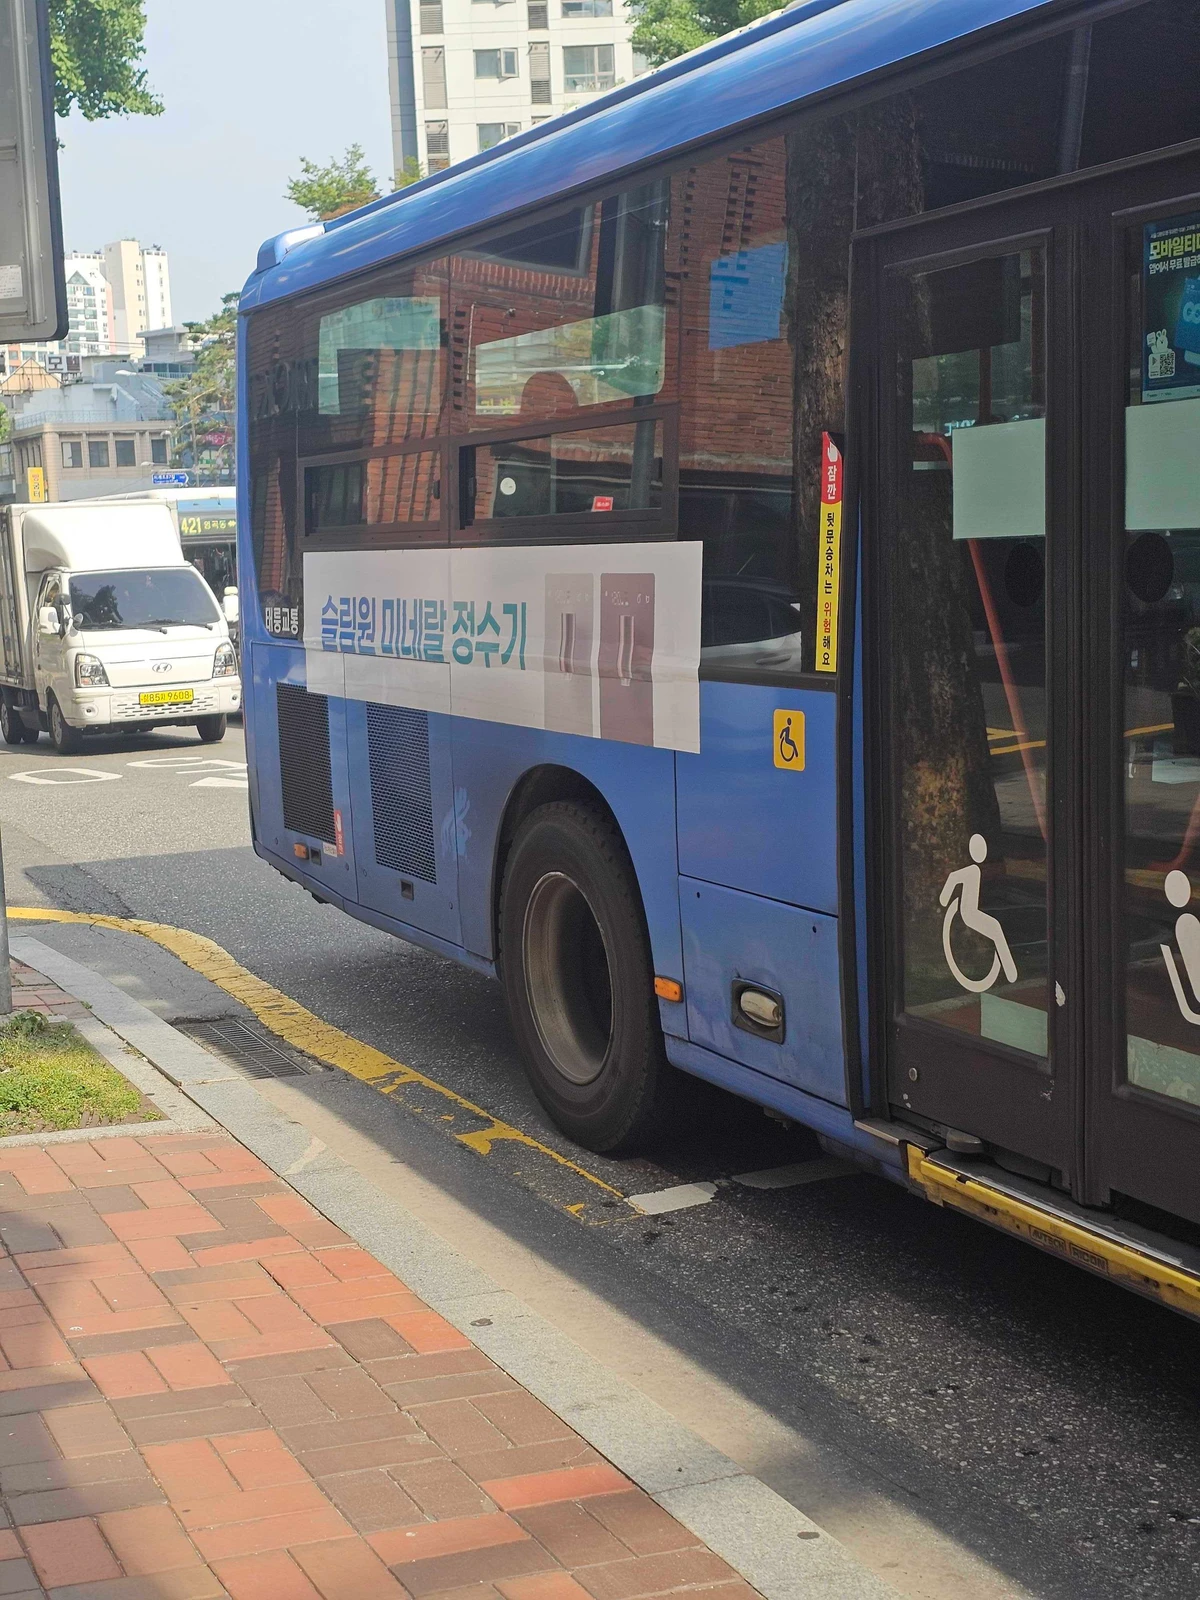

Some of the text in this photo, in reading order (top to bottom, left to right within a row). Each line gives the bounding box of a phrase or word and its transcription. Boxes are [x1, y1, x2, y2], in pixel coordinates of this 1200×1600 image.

[1149, 261, 1169, 275] 앱에서
[1169, 257, 1183, 270] 무료
[827, 465, 838, 501] 잠깐
[181, 516, 202, 535] 421
[265, 606, 299, 635] 태릉교통
[321, 594, 527, 671] 슬림원 미네랄 정수기
[821, 602, 832, 666] 위험해요
